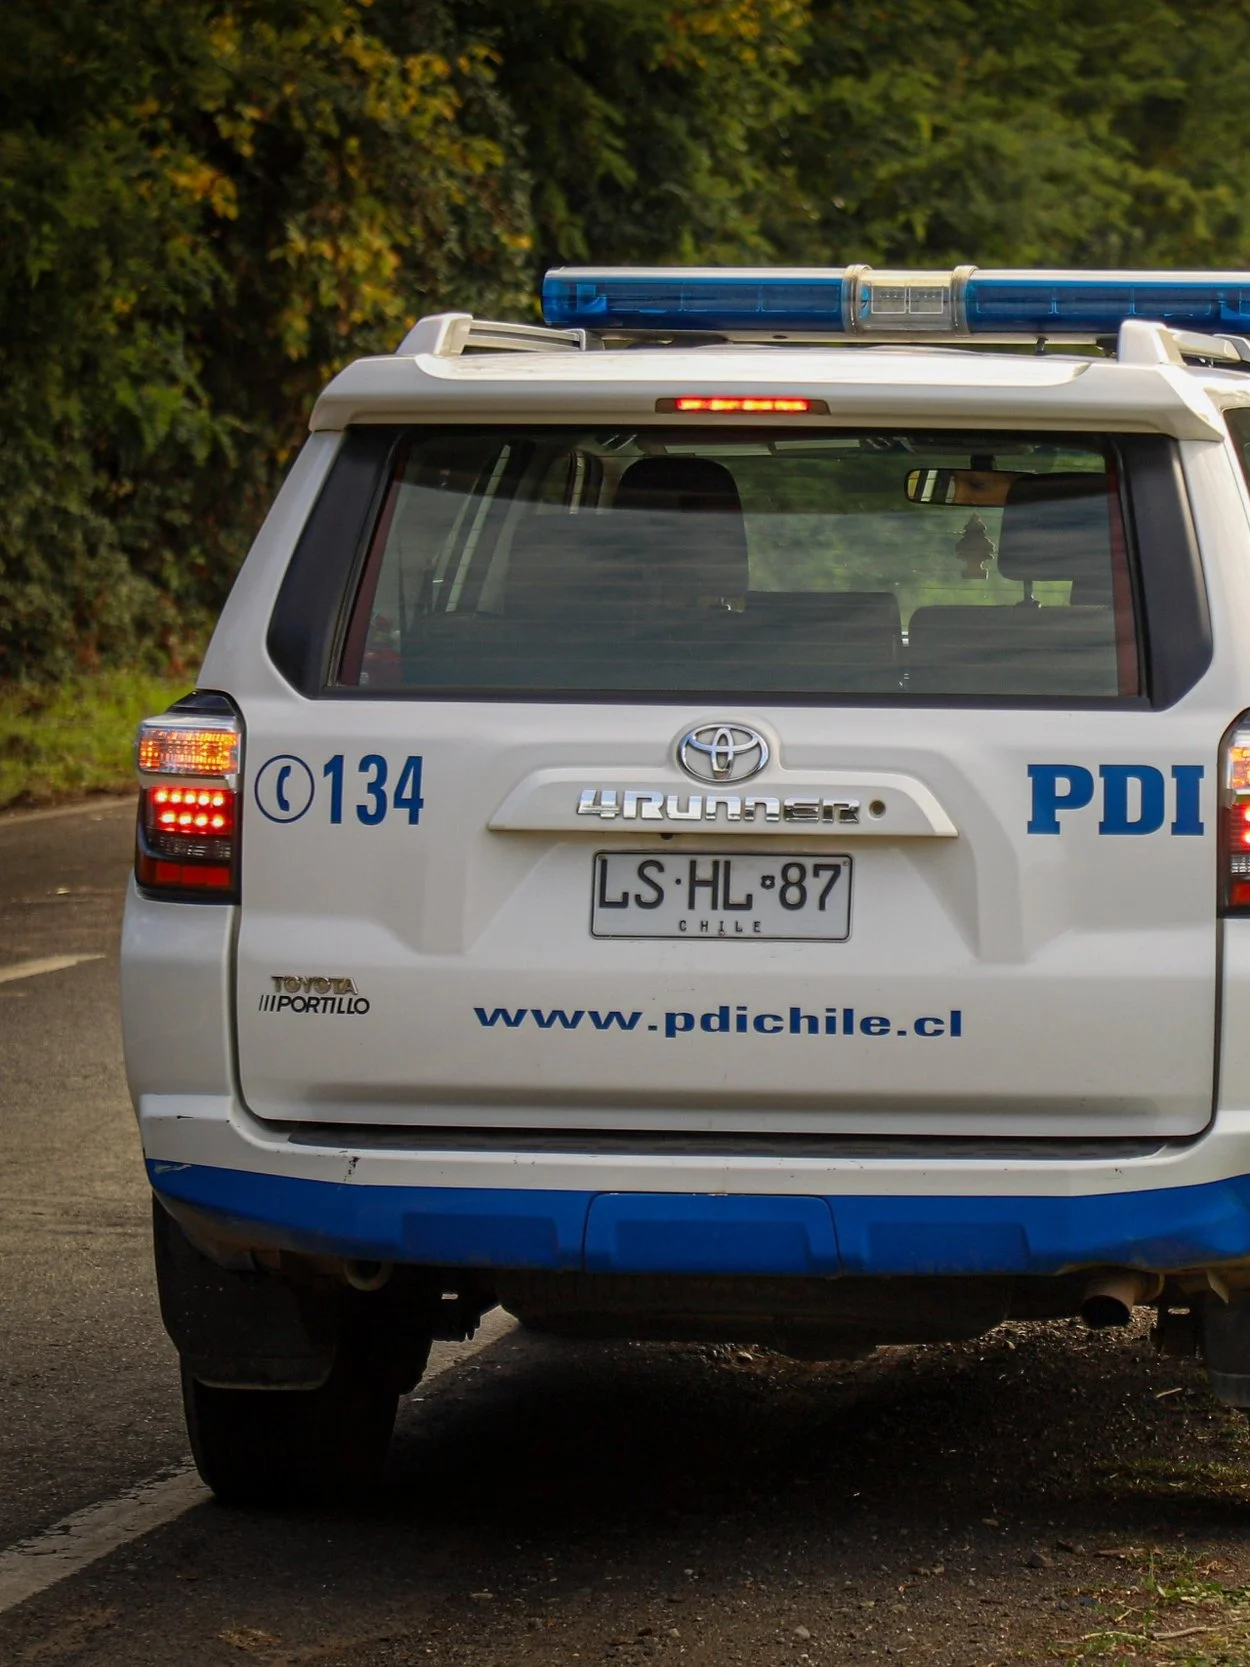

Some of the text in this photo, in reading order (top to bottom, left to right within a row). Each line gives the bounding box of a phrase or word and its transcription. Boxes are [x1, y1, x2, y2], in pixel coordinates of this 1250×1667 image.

[323, 754, 425, 826] 134
[1027, 763, 1205, 837] PDI
[678, 919, 762, 934] CHILE
[271, 975, 359, 995] TOYOTA
[473, 1005, 963, 1038] www.pdichile.cl
